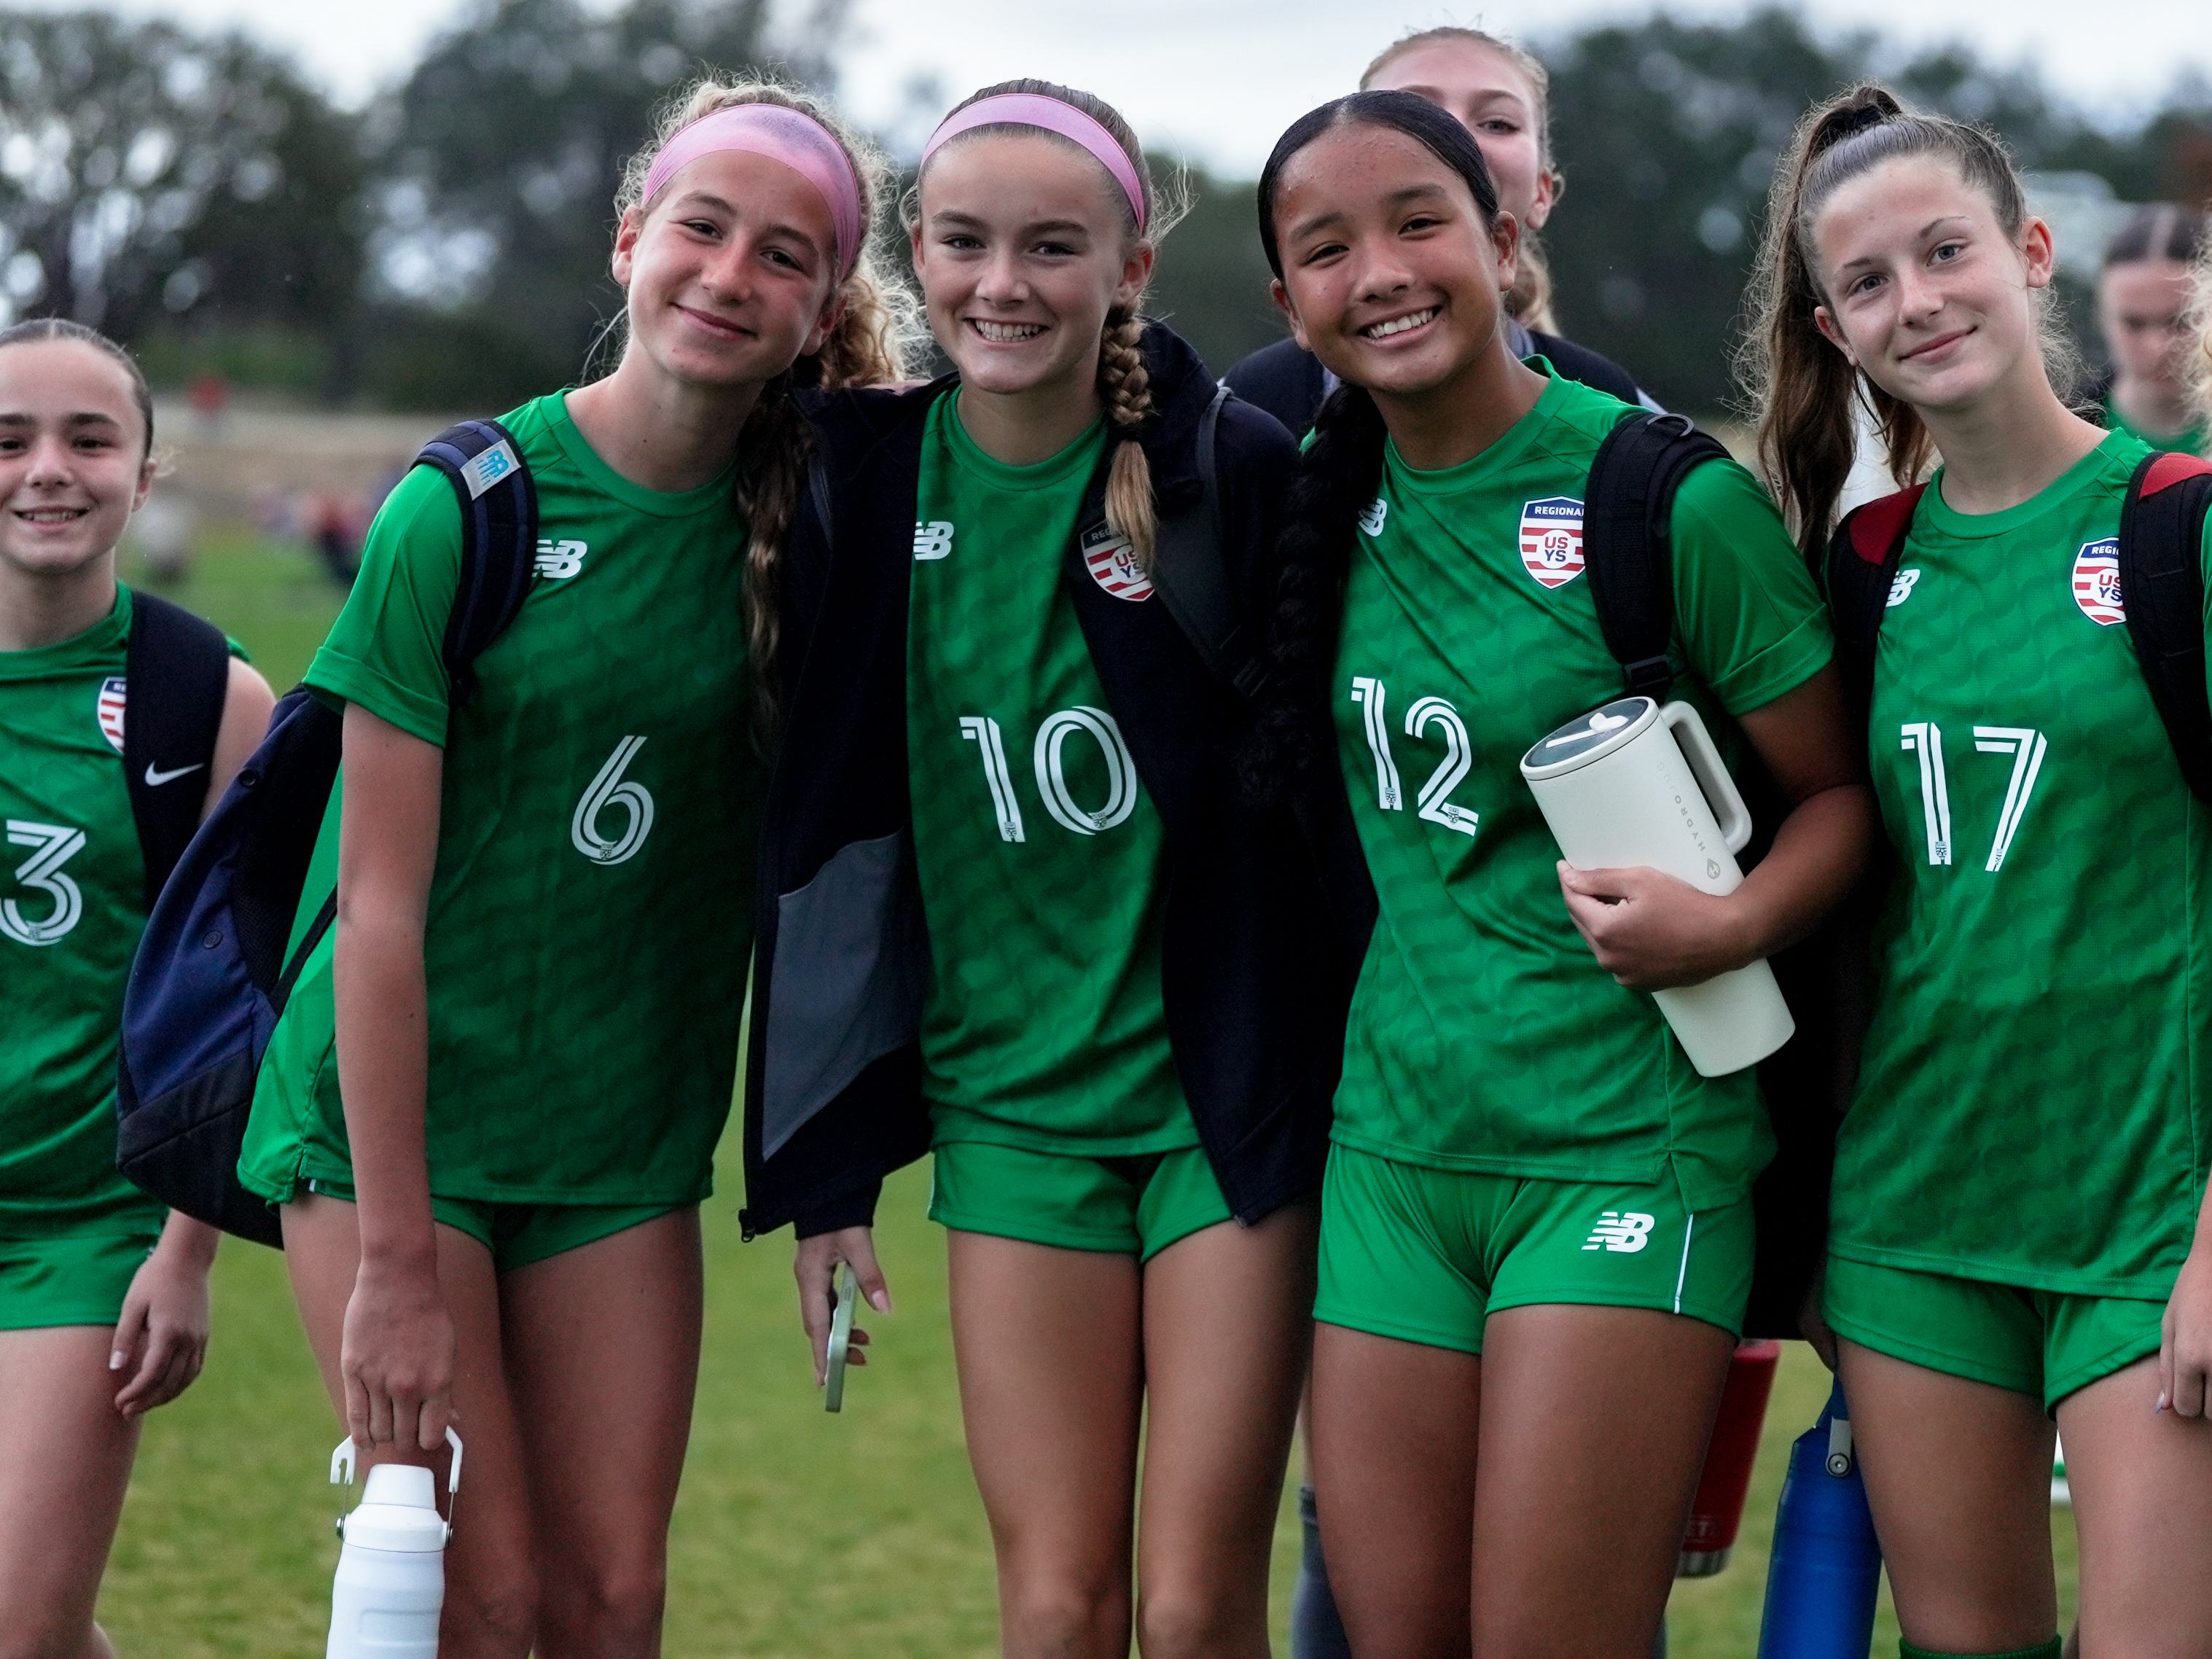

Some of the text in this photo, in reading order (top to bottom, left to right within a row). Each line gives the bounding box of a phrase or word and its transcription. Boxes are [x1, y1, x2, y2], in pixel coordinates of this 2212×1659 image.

[476, 450, 509, 486] NB
[1534, 506, 1584, 516] REGIONA
[1544, 536, 1568, 550] US
[1544, 549, 1567, 562] YS
[2098, 586, 2122, 602] YS
[958, 706, 1137, 843] 10
[1351, 676, 1479, 837] 12
[571, 735, 654, 865] 6
[1901, 722, 2048, 872] 17
[0, 819, 86, 946] 3
[1581, 1211, 1655, 1253] NB
